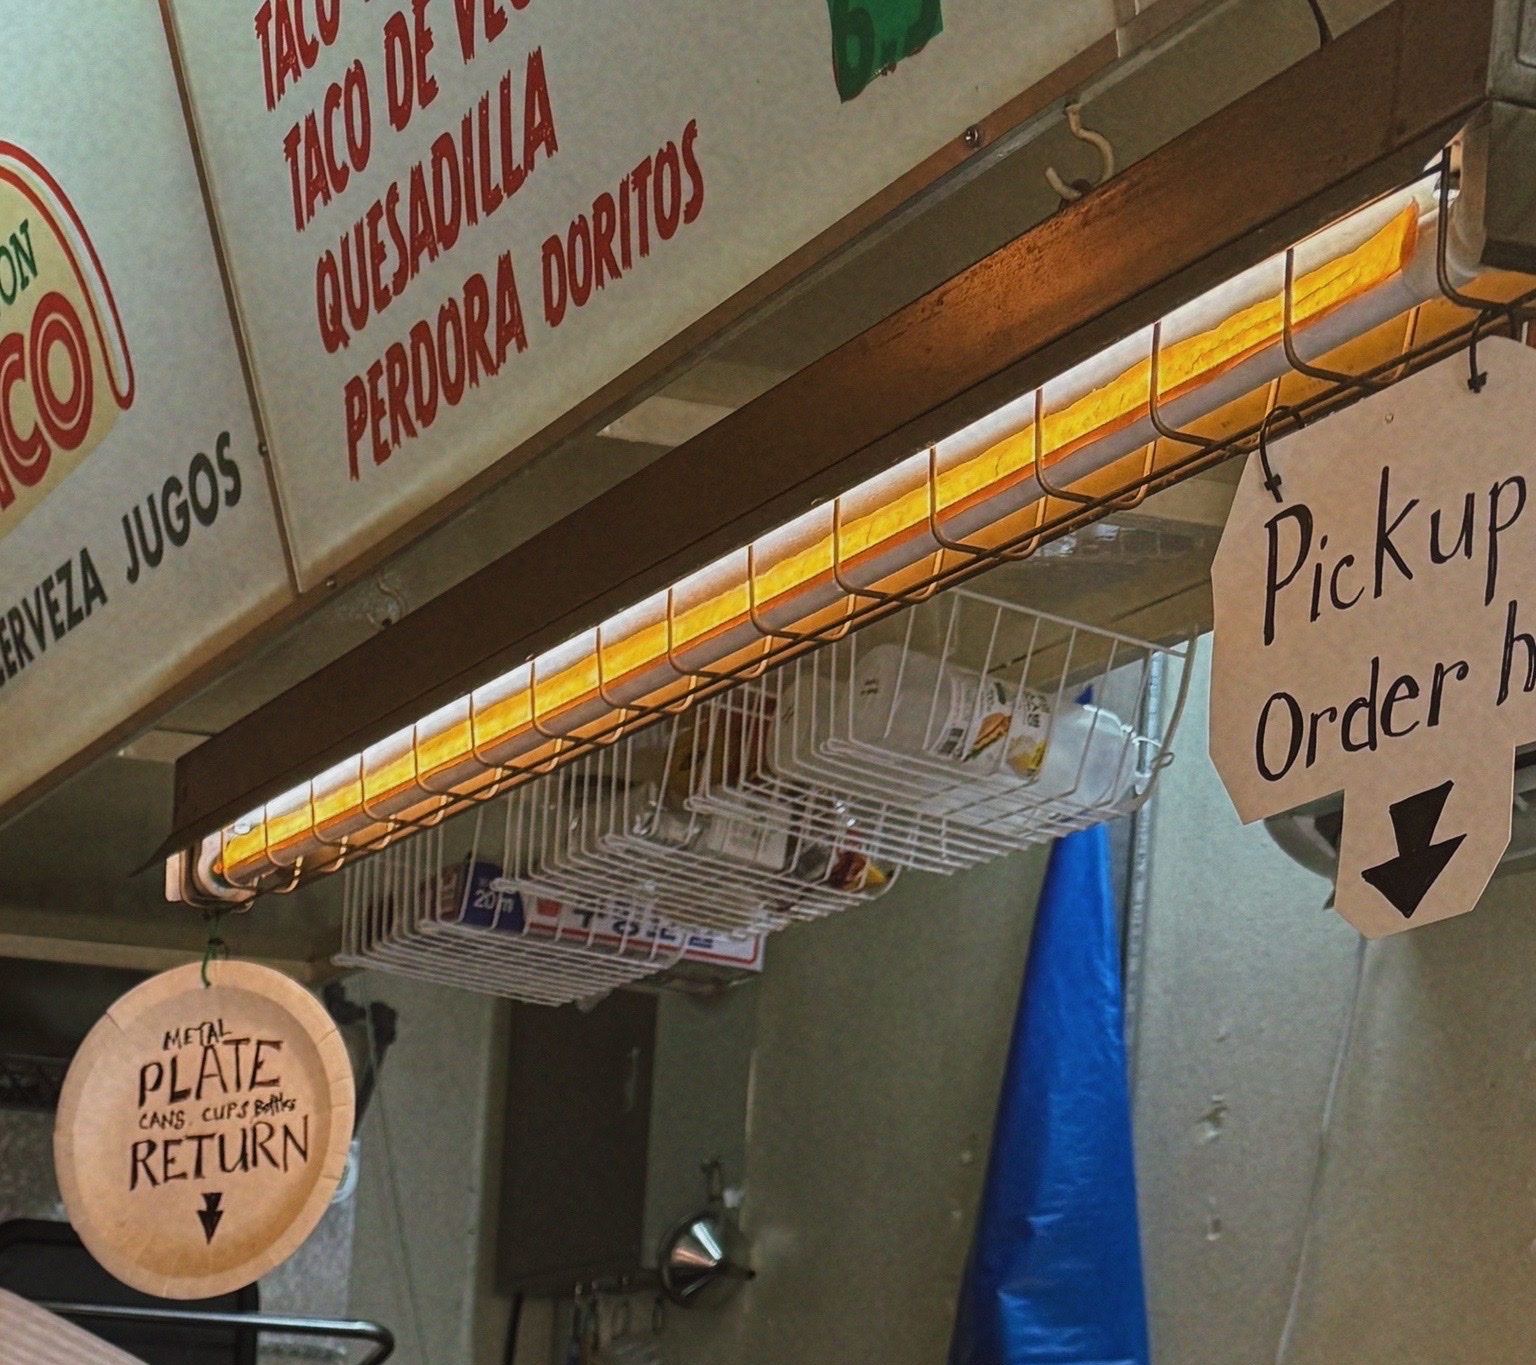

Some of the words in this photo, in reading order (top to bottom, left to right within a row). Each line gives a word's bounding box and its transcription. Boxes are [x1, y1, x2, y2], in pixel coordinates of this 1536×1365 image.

[282, 58, 371, 233] TACO
[383, 0, 440, 132] DE
[315, 45, 559, 354] QUESADILLA
[343, 249, 528, 482] PERDORA
[542, 118, 704, 329] DORITOS
[124, 430, 242, 587] JUGOS
[1262, 465, 1528, 647] Pickup
[1254, 655, 1469, 784] Order
[137, 1037, 283, 1108] PLATE
[162, 1018, 233, 1050] METAL
[129, 1113, 310, 1192] RETURN
